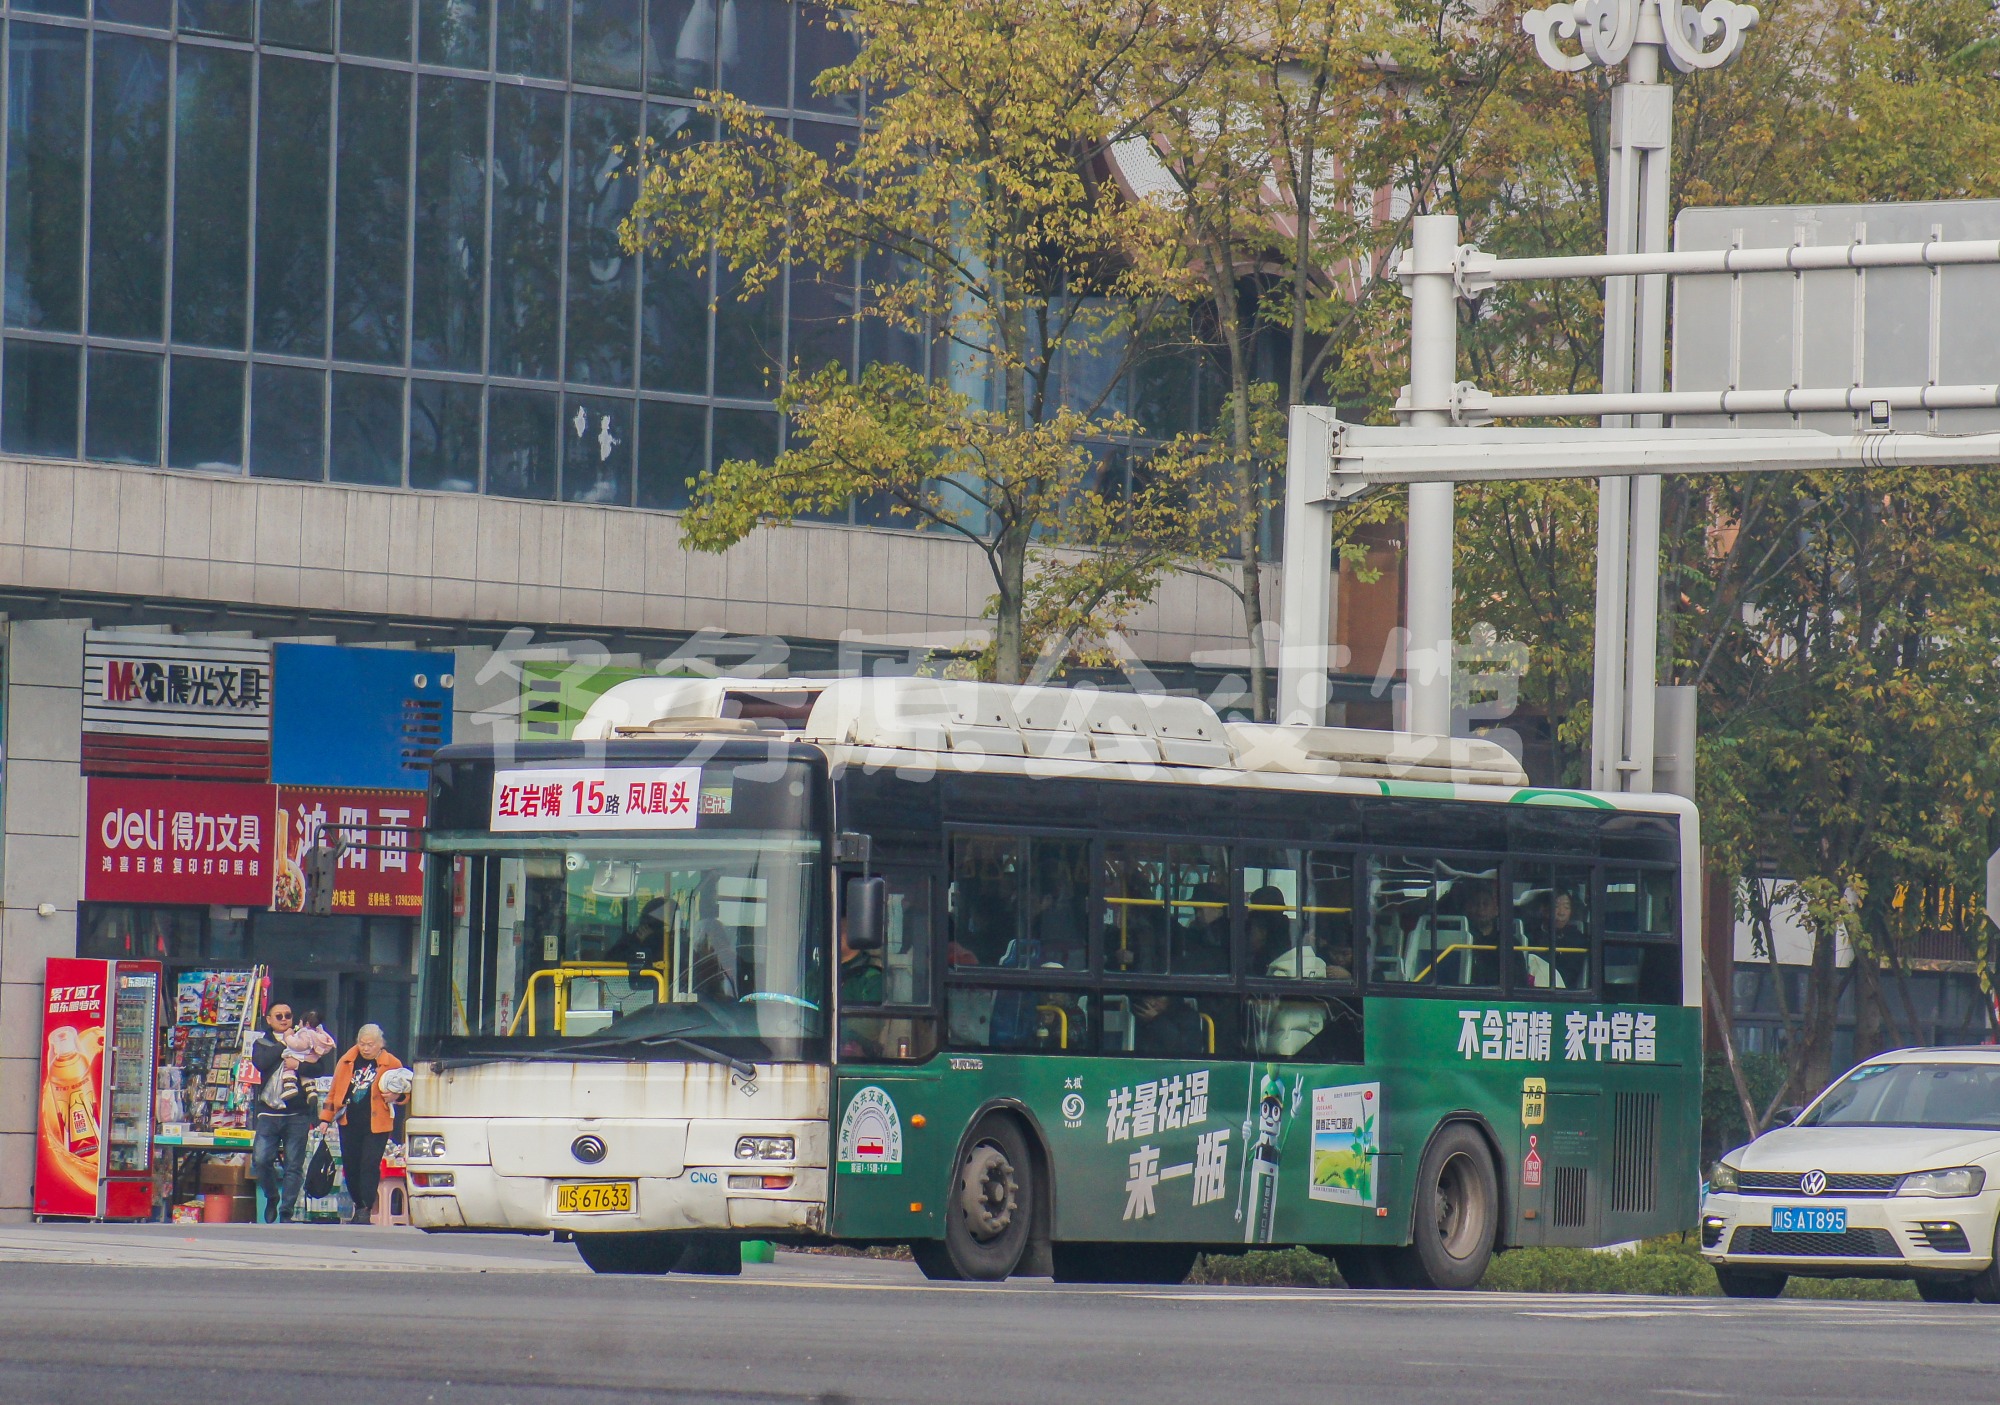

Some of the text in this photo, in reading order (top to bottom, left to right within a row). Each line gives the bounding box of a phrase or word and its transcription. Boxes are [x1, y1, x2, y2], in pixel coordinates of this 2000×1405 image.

[106, 661, 262, 708] M&G 晨光文具
[499, 783, 562, 817] 红岩嘴
[626, 781, 690, 815] 凤凰头
[101, 808, 260, 853] deli 得力文具
[295, 803, 426, 873] 鸿阳面
[102, 856, 259, 876] 鸿喜百货 复印打印照相
[50, 984, 101, 1001] 累了困了
[1457, 1009, 1656, 1062] 不含酒精 家中常备
[1106, 1070, 1210, 1144] 祛暑祛湿
[690, 1171, 718, 1184] CNG
[1122, 1128, 1230, 1220] 来一瓶
